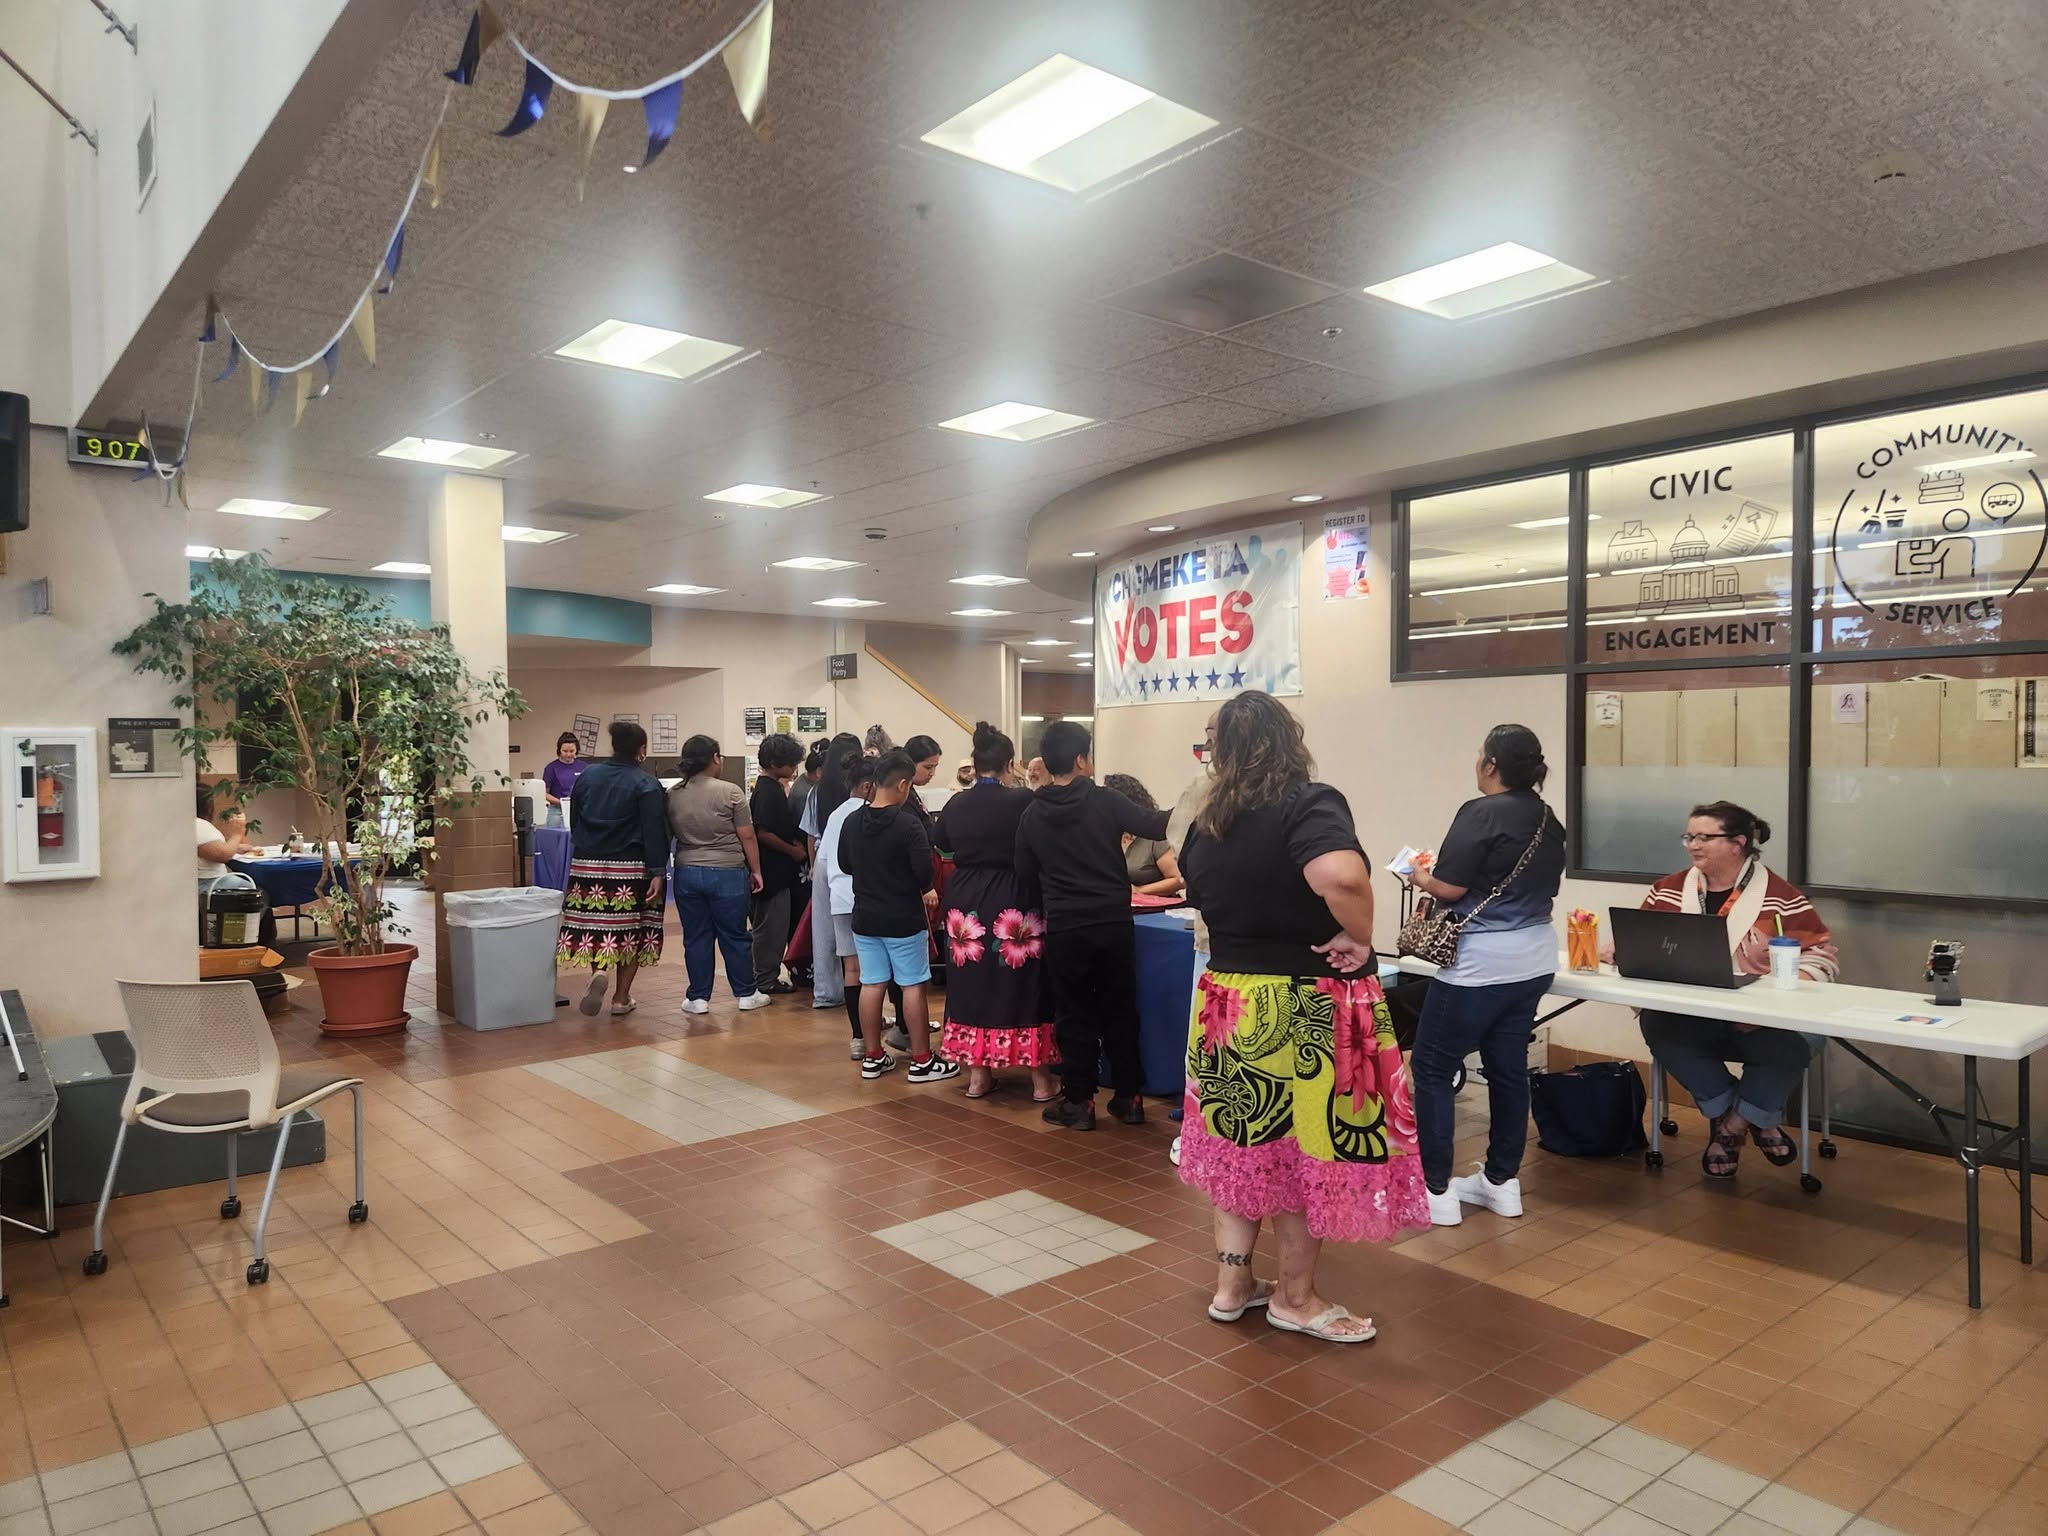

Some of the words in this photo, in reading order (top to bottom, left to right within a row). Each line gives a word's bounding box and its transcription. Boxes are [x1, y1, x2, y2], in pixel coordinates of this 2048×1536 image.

[1856, 424, 2033, 479] COMMUNITY
[1650, 466, 1732, 500] CIVIC
[1616, 547, 1649, 562] VOTE
[1110, 542, 1250, 603] CHEMEKETA
[1886, 596, 1999, 625] SERVICE
[1114, 590, 1255, 670] VOTES
[1605, 621, 1776, 651] ENGAGEMENT
[832, 657, 845, 668] Food
[1662, 935, 1678, 955] hp
